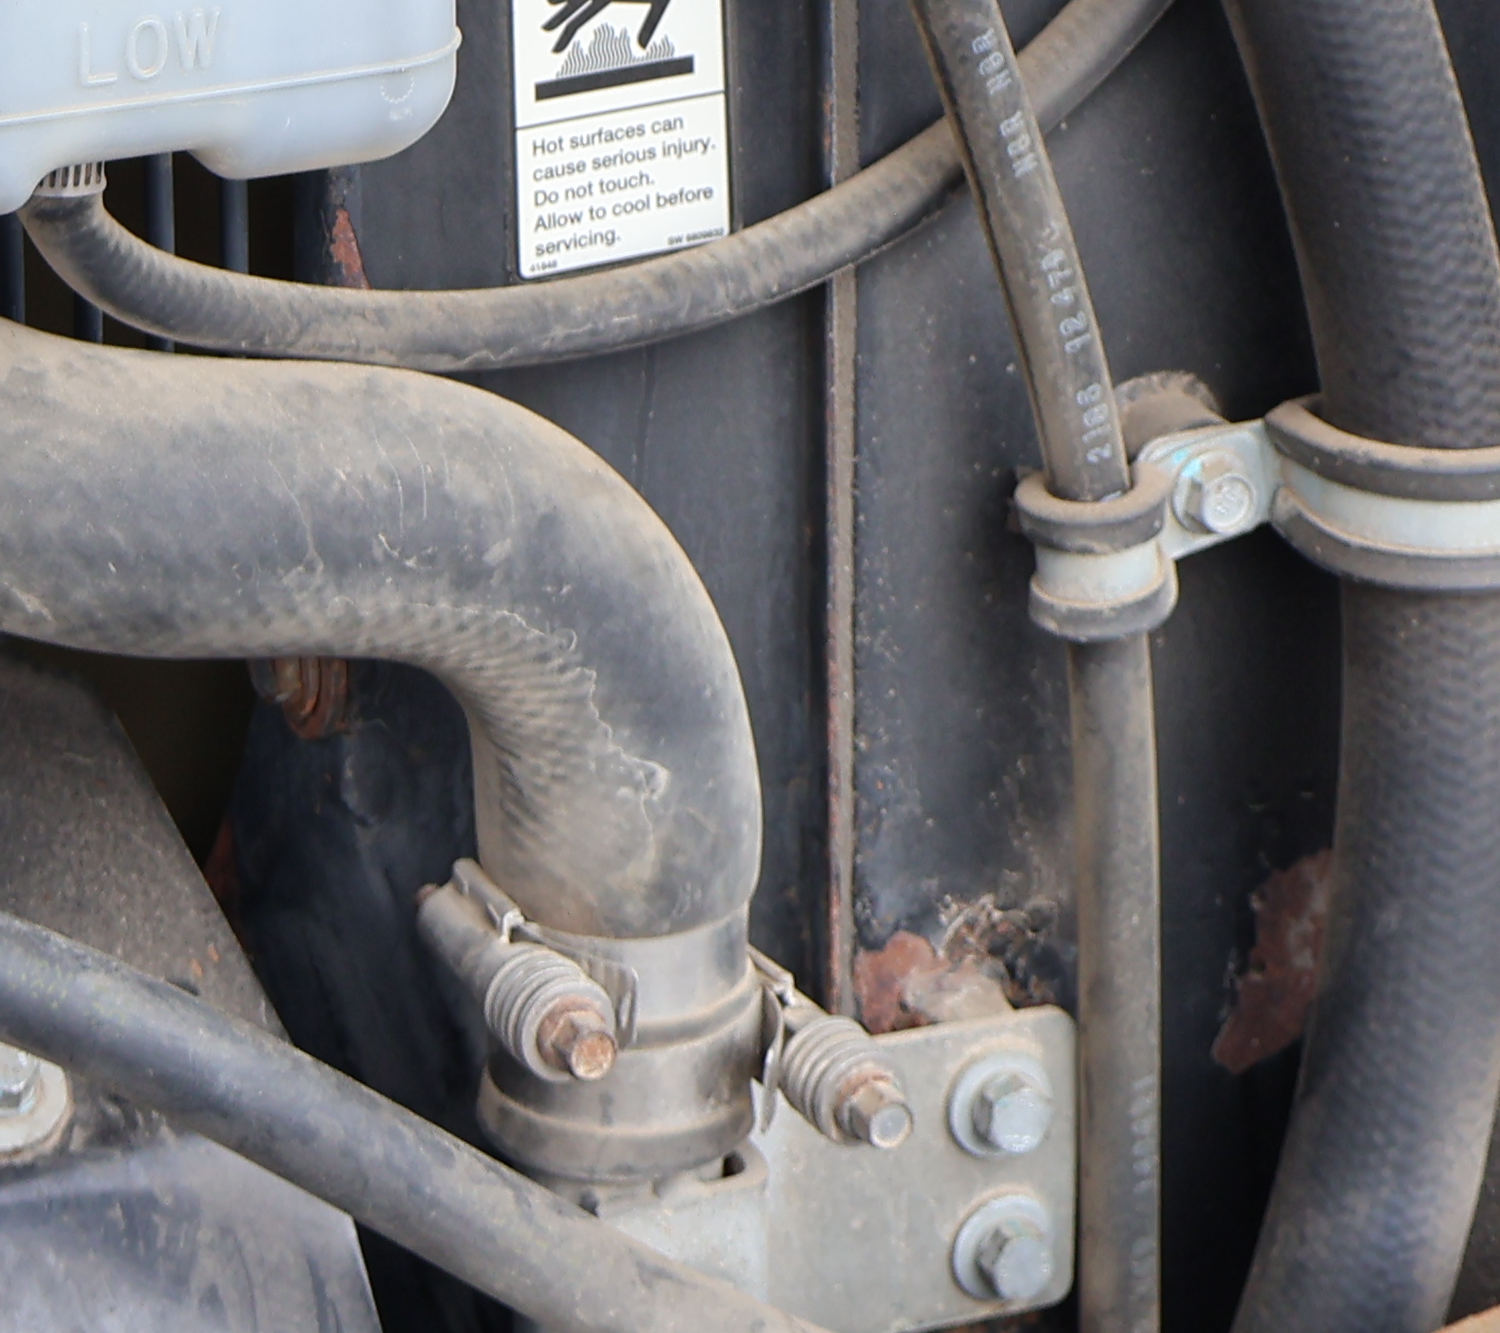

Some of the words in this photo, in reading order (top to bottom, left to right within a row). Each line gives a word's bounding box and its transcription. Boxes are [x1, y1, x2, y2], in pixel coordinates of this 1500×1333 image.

[79, 6, 223, 90] LOW
[532, 137, 564, 157] Hot
[570, 123, 645, 149] surfaces
[651, 116, 684, 134] can
[533, 161, 586, 182] cause
[592, 147, 657, 171] serious
[662, 136, 716, 161] injury.
[534, 189, 559, 207] Do
[565, 182, 593, 200] not
[599, 171, 655, 192] touch.
[534, 209, 583, 232] Allow
[589, 204, 607, 220] to
[612, 196, 650, 216] cool
[656, 184, 713, 207] before
[535, 228, 621, 257] servicing.
